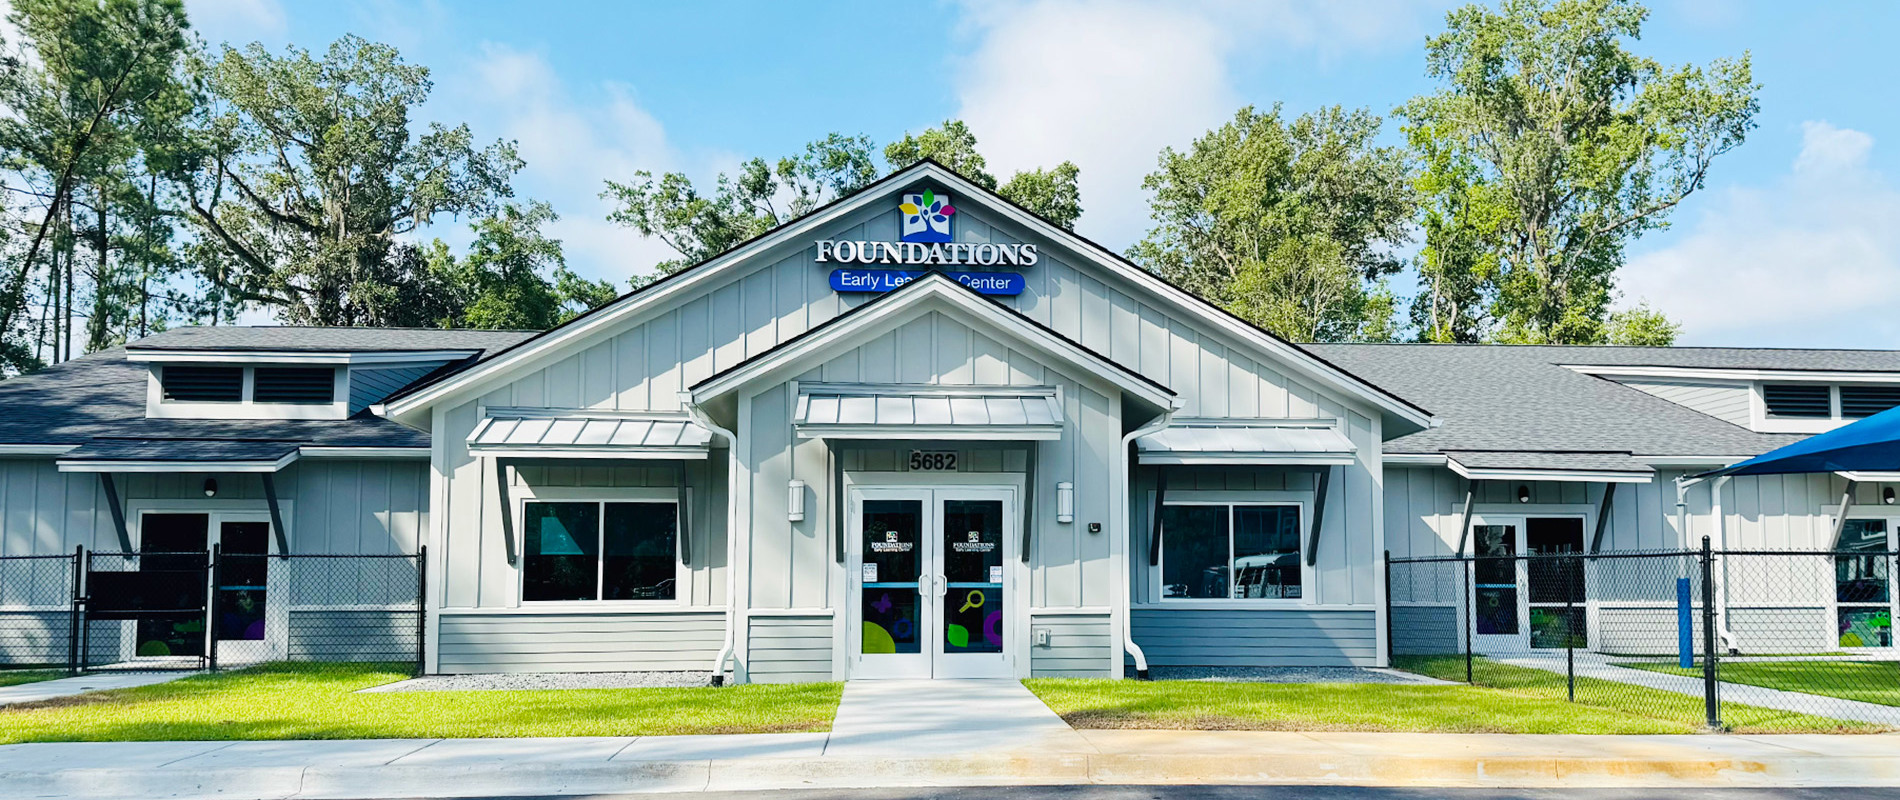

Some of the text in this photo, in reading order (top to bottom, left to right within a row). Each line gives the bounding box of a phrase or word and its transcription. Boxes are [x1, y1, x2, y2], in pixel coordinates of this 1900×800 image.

[814, 239, 1038, 266] FOUNDATIONS
[841, 272, 880, 290] Early
[958, 274, 1011, 289] Center
[910, 452, 956, 470] 5682
